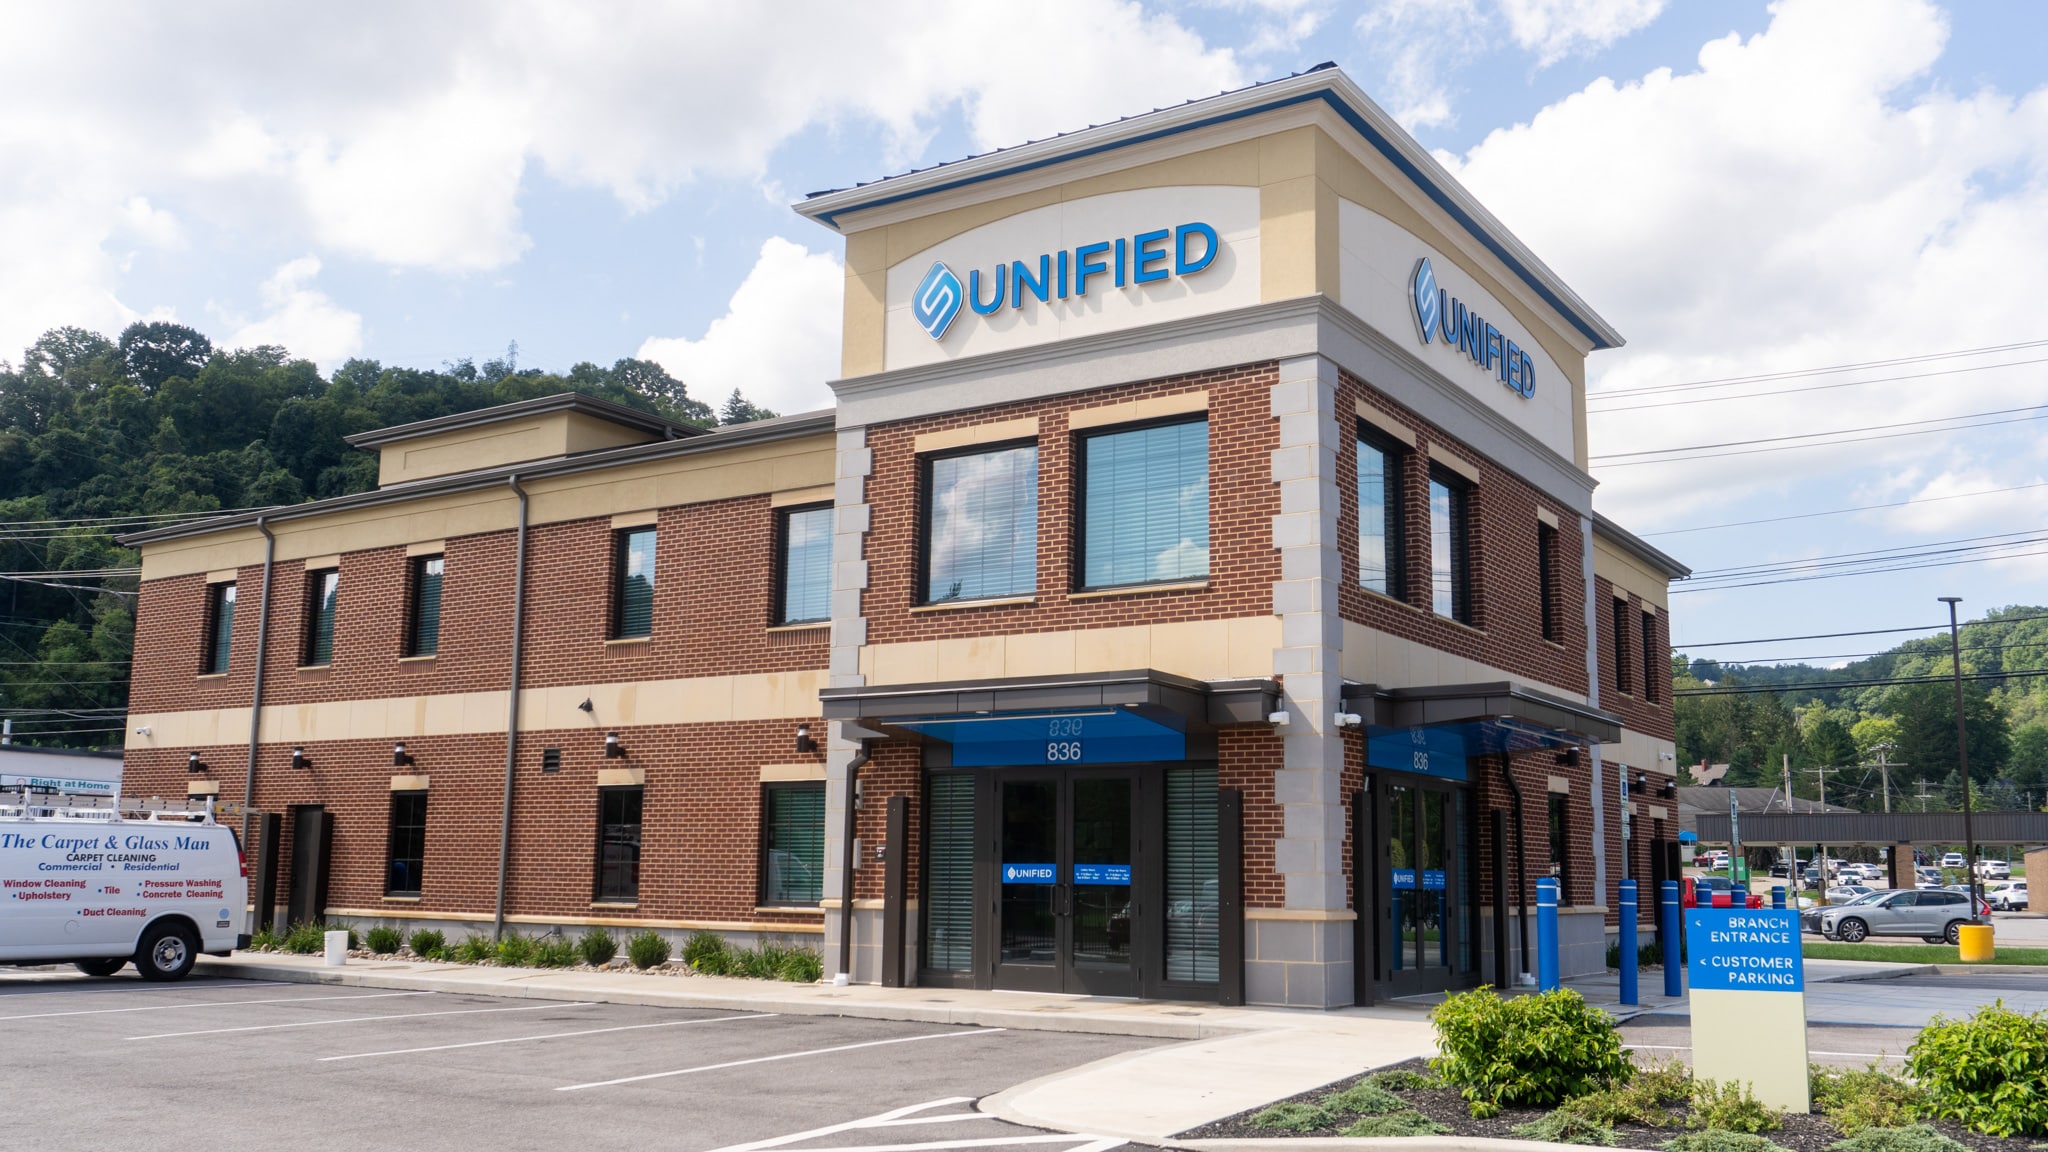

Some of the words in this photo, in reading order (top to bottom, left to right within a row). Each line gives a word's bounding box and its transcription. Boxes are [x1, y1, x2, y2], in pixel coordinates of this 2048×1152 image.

[969, 222, 1219, 315] UNIFIED
[1440, 288, 1535, 399] UNIFIED
[1047, 742, 1081, 760] 836
[1413, 751, 1428, 770] 836
[78, 781, 110, 790] Home
[1, 833, 36, 849] The
[41, 834, 99, 853] Carpet
[104, 835, 119, 850] &
[125, 835, 169, 850] Glass
[174, 836, 210, 850] Man
[66, 853, 104, 862] CARPET
[106, 854, 157, 862] CLEANING
[38, 862, 103, 871] Commercial
[124, 862, 180, 871] Residential
[1016, 869, 1052, 878] UNIFIED
[3, 879, 42, 888] Window
[44, 879, 87, 889] Cleaning
[145, 880, 184, 888] Pressure
[185, 879, 222, 888] Washing
[104, 886, 121, 894] Tile
[142, 890, 182, 899] Concrete
[186, 889, 223, 899] Cleaning
[18, 891, 72, 901] Upholstery
[83, 908, 105, 916] Duct
[106, 907, 147, 917] Cleaning
[1728, 917, 1789, 929] BRANCH
[1710, 931, 1790, 943] ENTRANCE
[1711, 956, 1793, 969] CUSTOMER
[1728, 972, 1795, 985] PARKING
